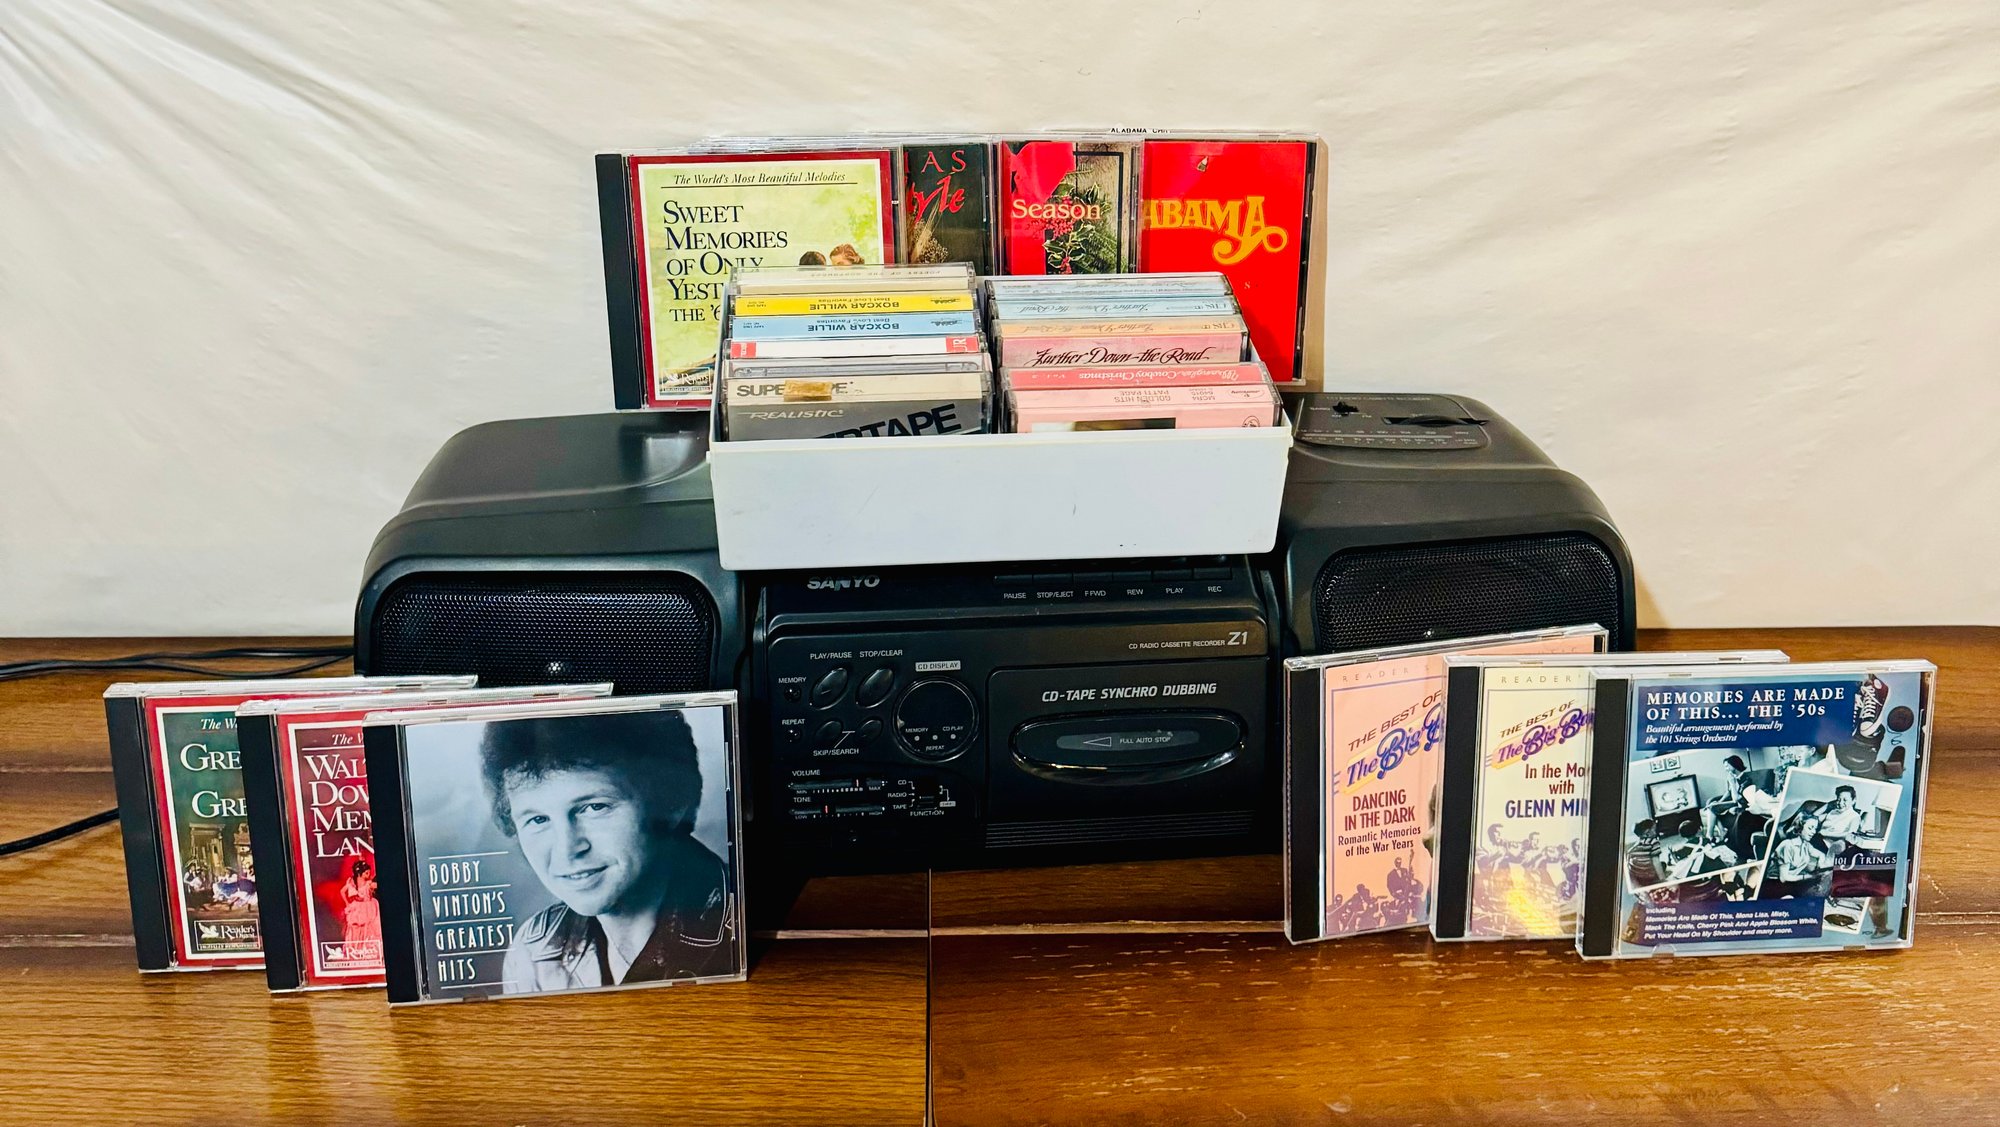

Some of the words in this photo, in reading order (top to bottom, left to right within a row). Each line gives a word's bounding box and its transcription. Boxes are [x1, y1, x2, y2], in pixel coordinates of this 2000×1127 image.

[673, 174, 691, 185] The
[693, 173, 728, 184] World's
[731, 173, 755, 184] Most
[758, 172, 802, 184] Beautiful
[805, 171, 846, 182] Melodies
[663, 200, 744, 225] SWEET
[1011, 200, 1101, 220] Season
[664, 226, 788, 251] MEMORIES
[666, 258, 696, 276] OF
[809, 303, 848, 311] WILLIE
[851, 301, 900, 310] BOXCAR
[669, 308, 706, 322] THE
[808, 324, 847, 332] WILLIE
[850, 323, 900, 331] BOXCAR
[1025, 348, 1088, 366] Further
[1159, 346, 1216, 363] Road
[1079, 372, 1135, 381] Christmas
[1135, 370, 1178, 380] Cowboy
[1113, 396, 1135, 404] HITS
[807, 575, 880, 590] SANYO
[1036, 591, 1074, 599] STOP/EJECT
[1227, 631, 1249, 646] Z1
[809, 651, 853, 660] PLAY/PAUSE
[859, 649, 903, 658] STOP/CLEAR
[917, 662, 928, 670] CD
[929, 661, 959, 670] DISPLAY
[778, 676, 807, 684] MEMORY
[1041, 688, 1097, 702] CD-TAPE
[1100, 686, 1158, 700] SYNCHRO
[1162, 683, 1218, 697] DUBBING
[1647, 690, 1744, 706] MEMORIES
[1751, 689, 1786, 703] ARE
[1793, 687, 1845, 701] MADE
[1500, 722, 1523, 738] THE
[1526, 708, 1556, 728] BEST
[1558, 698, 1575, 713] OF
[1646, 708, 1670, 721] OF
[1678, 706, 1740, 720] THIS...
[1748, 704, 1783, 718] THE
[1791, 703, 1826, 718] '50s
[200, 718, 222, 730] The
[781, 718, 806, 726] REPEAT
[1348, 728, 1377, 752] THE
[1380, 703, 1419, 733] BEST
[1422, 690, 1442, 708] OF
[1646, 722, 1682, 734] Beautiful
[1683, 722, 1735, 734] arrangements
[1735, 721, 1773, 733] performed
[1774, 720, 1784, 732] by
[332, 734, 353, 746] The
[1497, 743, 1523, 764] The
[1521, 724, 1559, 761] Big
[1646, 734, 1658, 744] the
[1659, 734, 1673, 743] 101
[1674, 734, 1701, 744] Strings
[1702, 733, 1738, 743] Orchestra
[180, 743, 242, 772] GRE
[812, 748, 860, 757] SKIP/SEARCH
[1346, 757, 1378, 787] The
[1376, 727, 1422, 780] Big
[792, 769, 821, 778] VOLUME
[1525, 763, 1537, 779] In
[1542, 763, 1562, 778] the
[1549, 780, 1575, 795] with
[1352, 789, 1407, 812] DANCING
[1505, 798, 1555, 819] GLENN
[1344, 814, 1357, 832] IN
[1360, 811, 1380, 829] THE
[1384, 805, 1416, 826] DARK
[1338, 831, 1378, 846] Romantic
[1380, 826, 1422, 840] Memories
[1346, 846, 1354, 857] of
[1356, 844, 1370, 856] the
[1372, 842, 1390, 853] War
[1392, 839, 1414, 850] Years
[1834, 856, 1847, 865] 101
[1840, 852, 1897, 871] STRINGS
[429, 860, 480, 886] BOBBY
[432, 891, 506, 918] VINTON'S
[1646, 906, 1677, 914] Including
[1678, 914, 1690, 922] Are
[1736, 912, 1754, 920] Mona
[221, 925, 256, 940] Reader's
[1697, 922, 1718, 930] Cherry
[1736, 920, 1749, 928] And
[1750, 920, 1768, 928] Apple
[436, 924, 514, 951] GREATEST
[1644, 932, 1656, 940] Put
[1691, 930, 1700, 938] On
[1702, 930, 1712, 938] My
[1756, 928, 1774, 936] many
[438, 958, 476, 982] HITS
